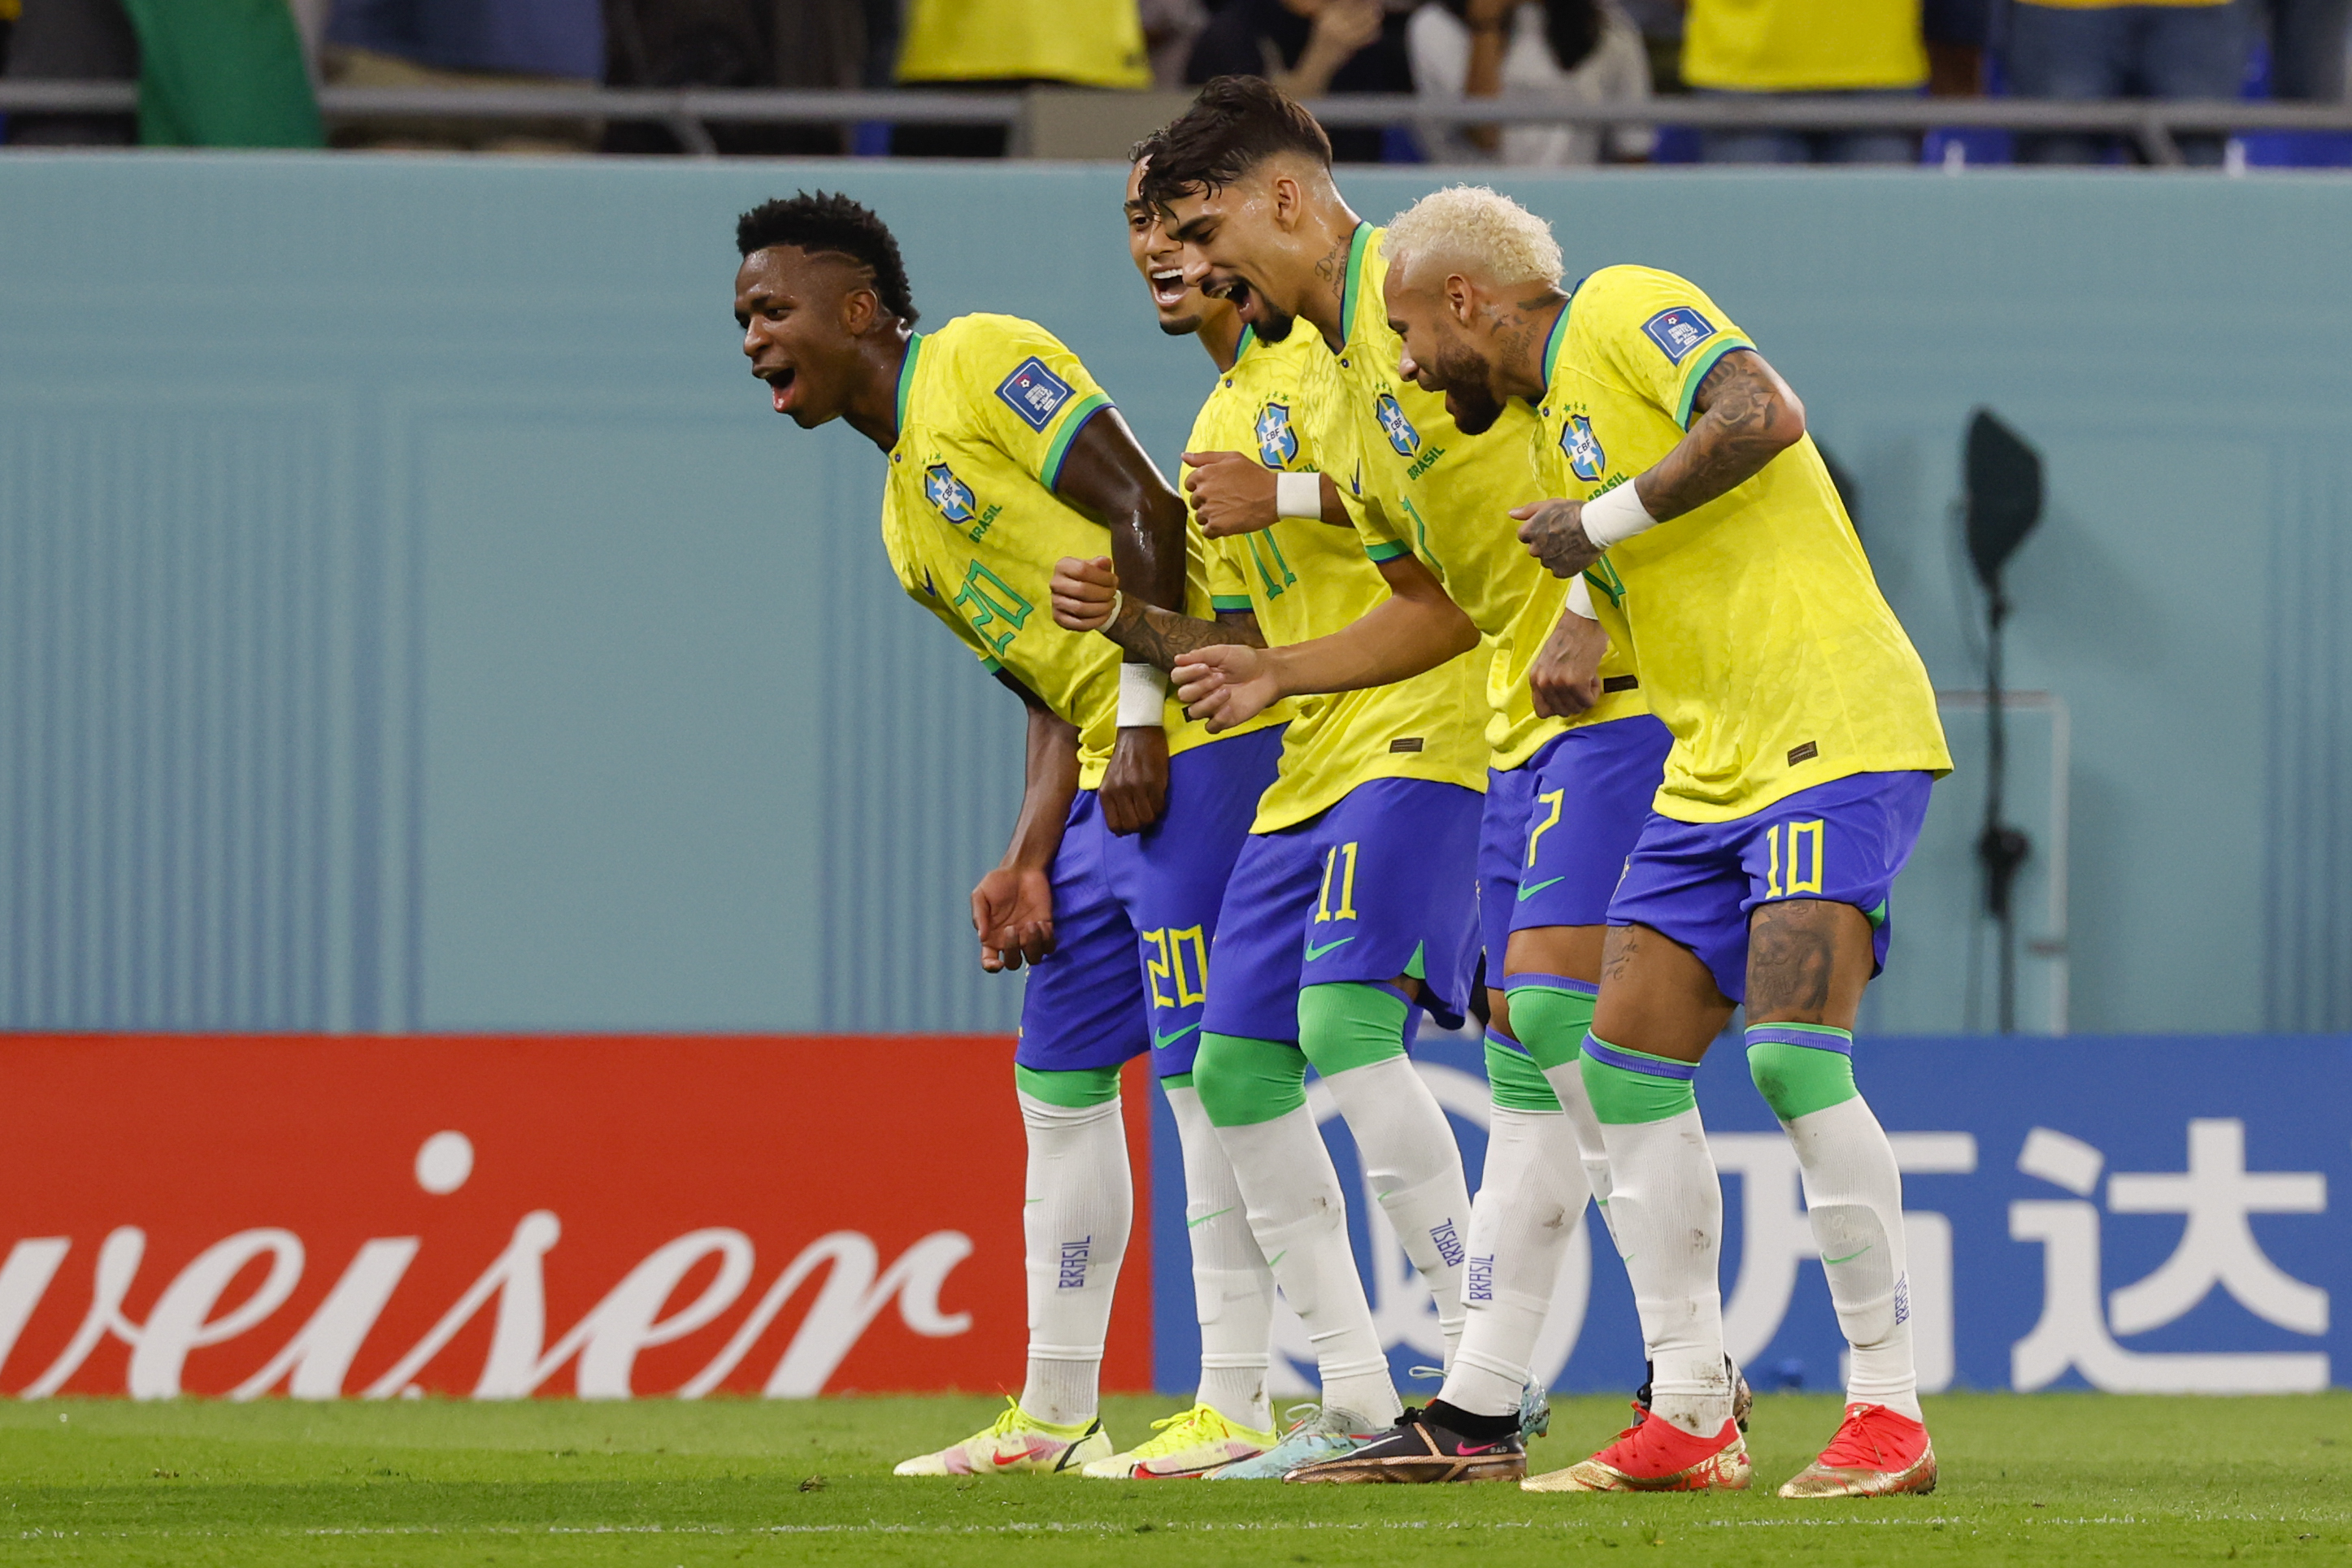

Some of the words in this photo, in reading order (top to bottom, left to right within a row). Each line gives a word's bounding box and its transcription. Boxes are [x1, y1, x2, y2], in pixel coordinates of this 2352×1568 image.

[1266, 428, 1280, 441] CBF
[1391, 417, 1402, 431] CBF
[1576, 439, 1591, 454] CBF
[1406, 446, 1446, 480] BRASIL
[942, 484, 954, 501] CBF
[968, 504, 1003, 543] BRASIL
[953, 558, 1034, 658] 20
[1528, 787, 1565, 869] 7
[1314, 840, 1359, 925] 11
[1765, 819, 1824, 901] 10
[1141, 923, 1208, 1010] 20
[1059, 1235, 1091, 1288] BRASIL
[1429, 1217, 1465, 1267] BRASIL
[1704, 1117, 2330, 1395] 万达
[1468, 1253, 1494, 1301] BRASIL
[1894, 1270, 1911, 1326] BRASIL
